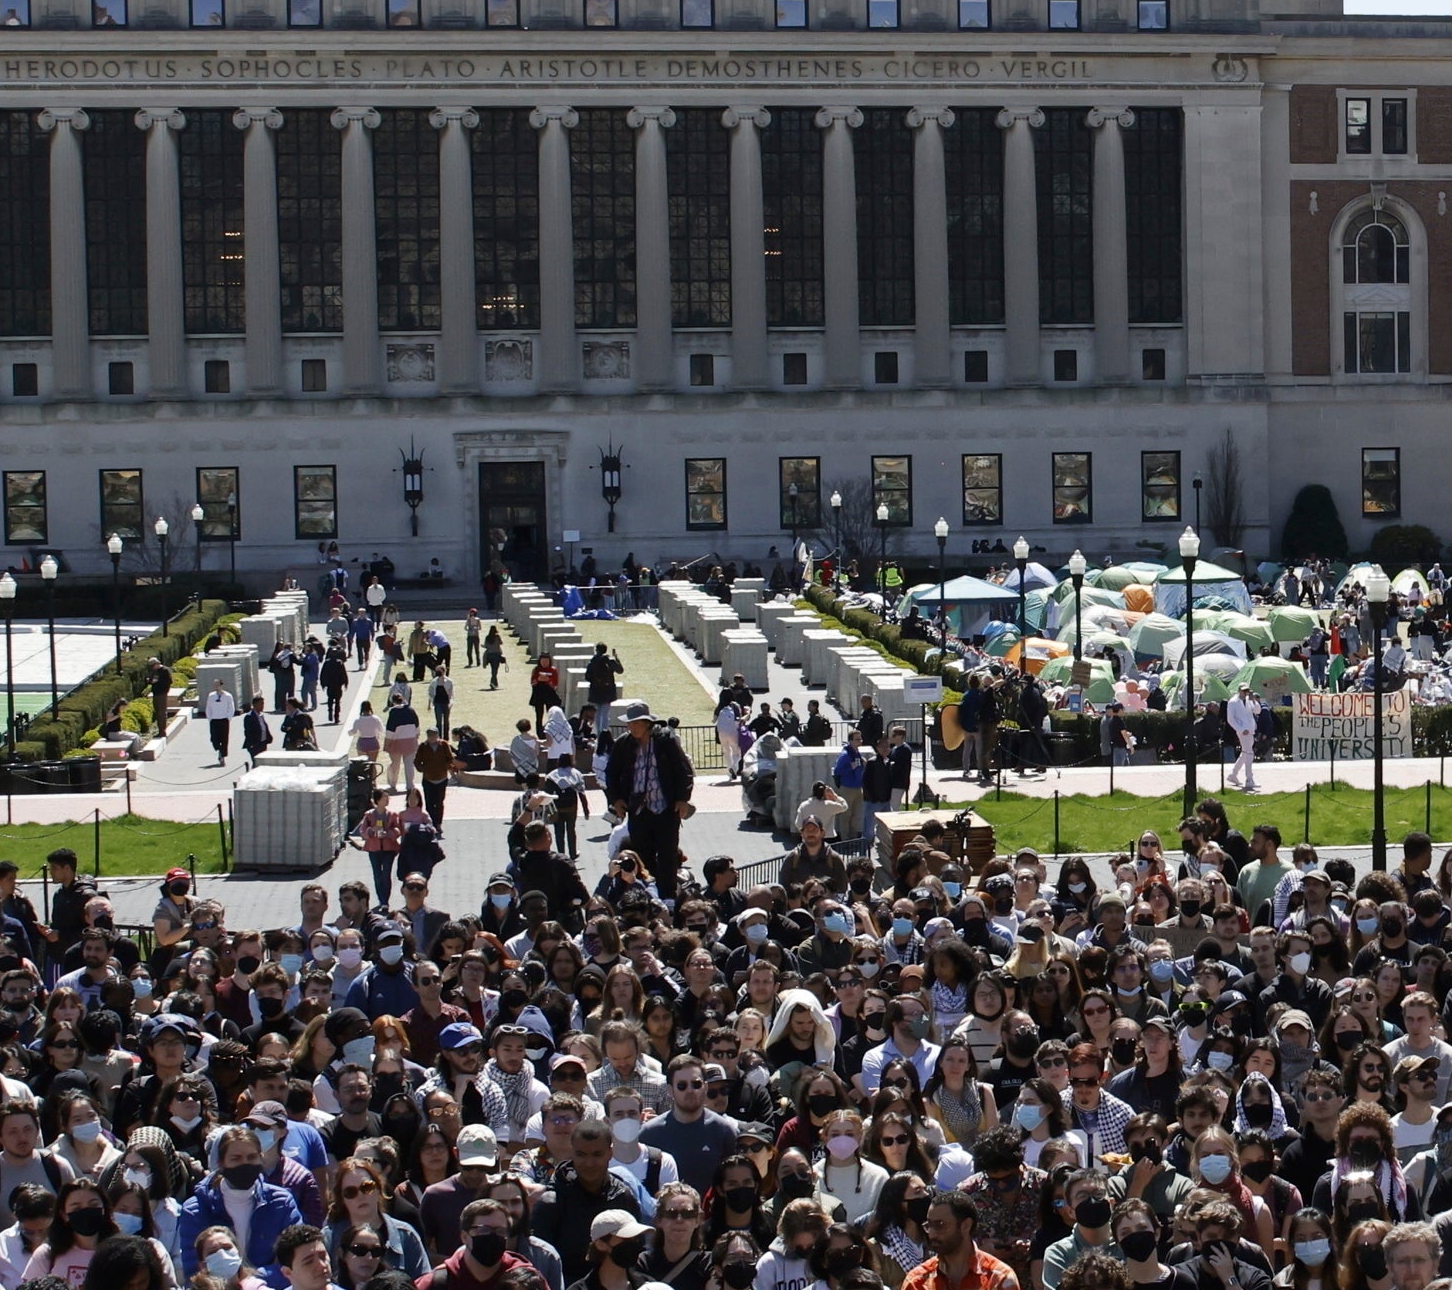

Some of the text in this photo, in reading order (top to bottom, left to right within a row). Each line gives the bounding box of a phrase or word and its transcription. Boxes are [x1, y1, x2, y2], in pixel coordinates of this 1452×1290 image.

[5, 60, 177, 79] HERODOTUS
[201, 60, 362, 78] SOPHOCLES
[386, 60, 475, 78] PLATO
[500, 60, 647, 78] ARISTOTLE
[667, 60, 863, 78] DEMOSTHENES
[884, 60, 981, 79] CICERO
[1001, 60, 1093, 79] VERGIL
[1299, 690, 1406, 717] WELCOME TO
[1298, 716, 1321, 729] THE
[1297, 736, 1407, 760] UNIVERSTY
